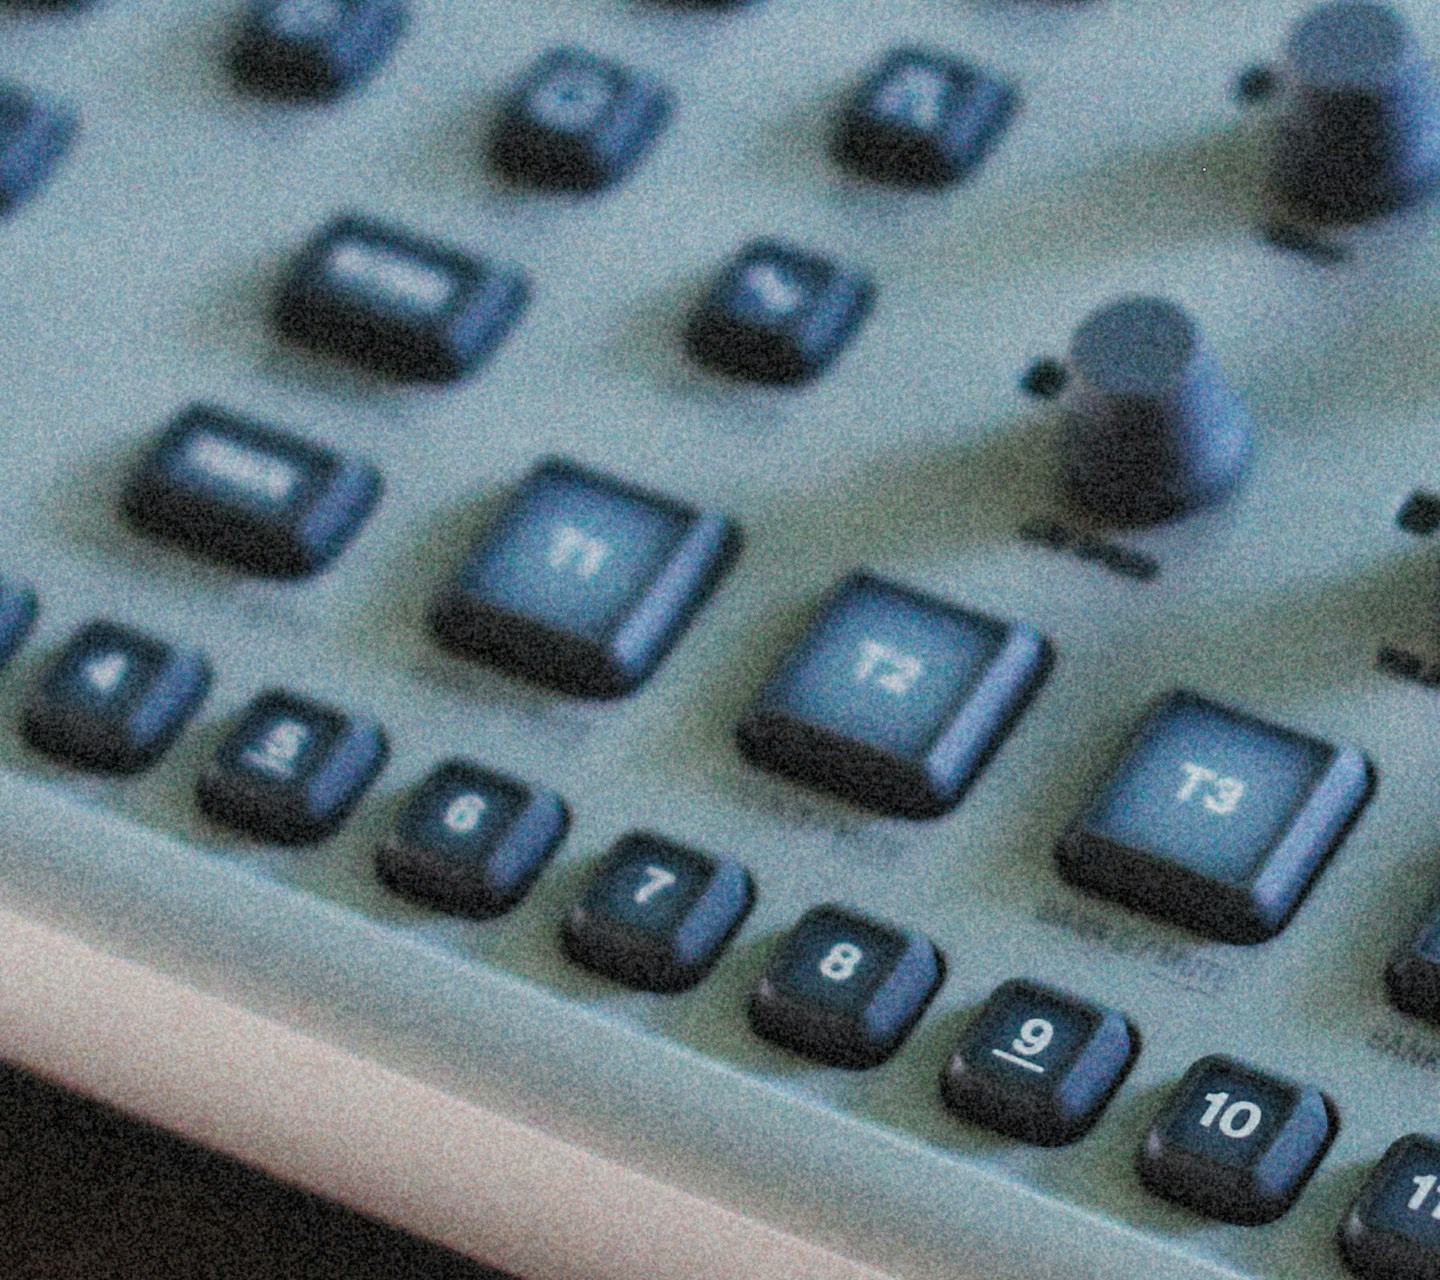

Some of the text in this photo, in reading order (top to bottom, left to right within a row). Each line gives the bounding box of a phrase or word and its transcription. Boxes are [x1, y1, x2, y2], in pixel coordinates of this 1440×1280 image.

[547, 526, 609, 580] T1
[82, 651, 128, 693] 4
[854, 639, 923, 695] T2
[264, 718, 309, 766] 5
[1175, 761, 1247, 816] T3
[444, 794, 485, 832] 6
[635, 864, 676, 904] 7
[819, 941, 863, 981] 8
[1010, 1016, 1054, 1058] 9
[1200, 1092, 1262, 1140] 10
